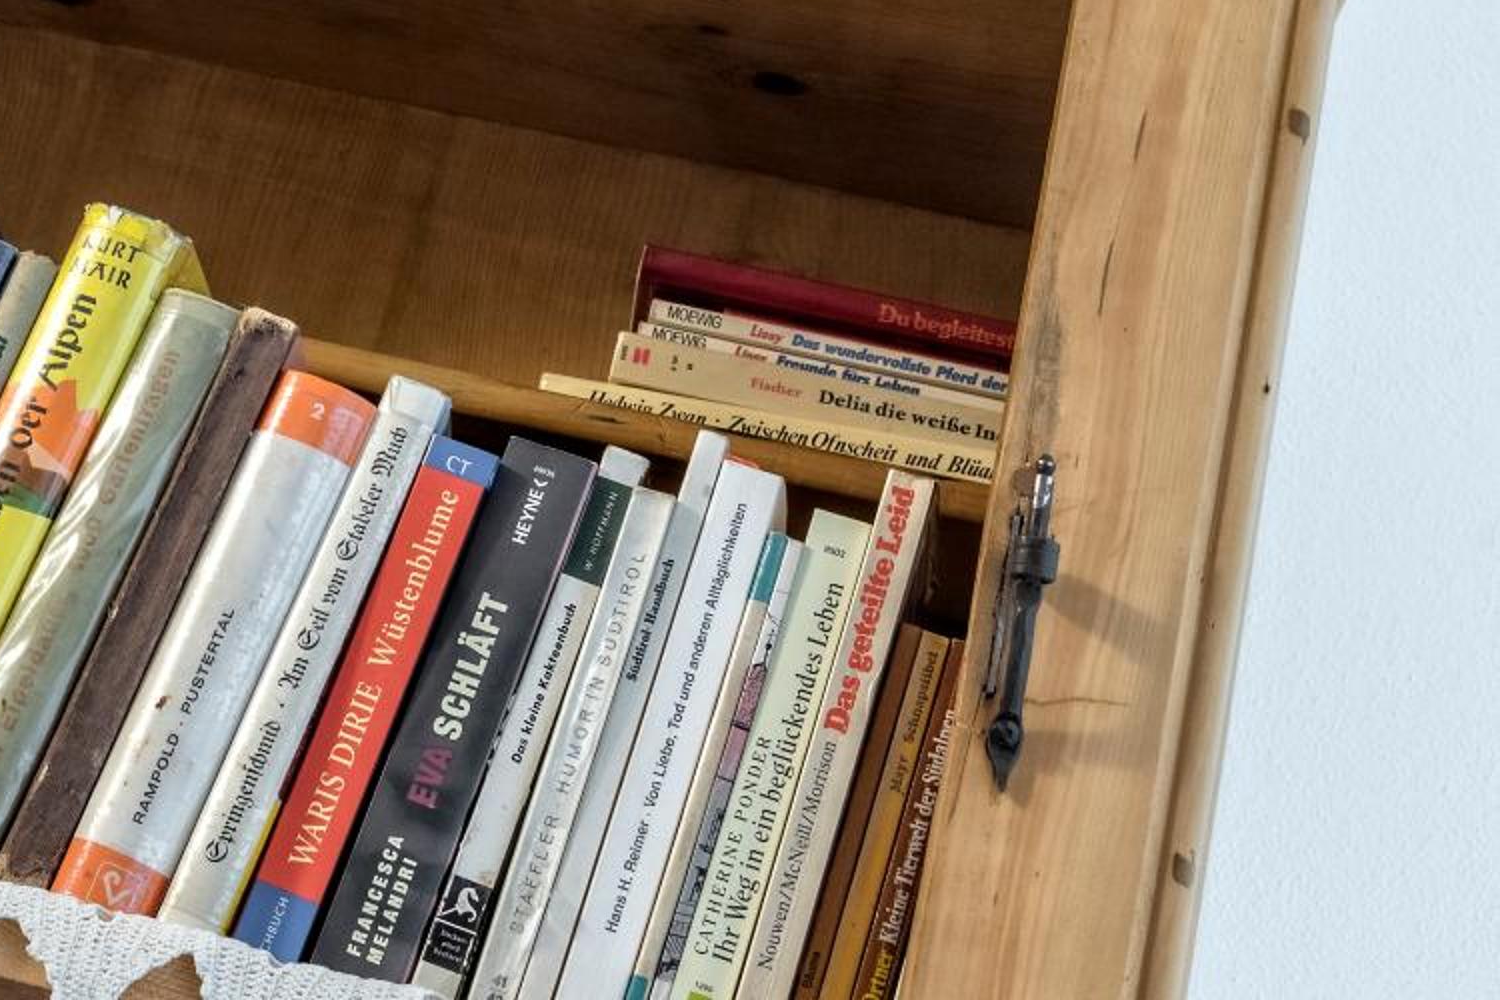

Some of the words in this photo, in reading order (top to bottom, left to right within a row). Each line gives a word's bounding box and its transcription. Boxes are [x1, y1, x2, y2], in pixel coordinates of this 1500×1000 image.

[32, 286, 102, 393] Alpen
[667, 305, 723, 328] MOEWIG
[877, 303, 909, 326] Du
[776, 355, 837, 378] Freunde
[841, 366, 871, 386] fürs
[875, 375, 921, 396] Leben
[792, 334, 820, 351] Das
[825, 344, 932, 375] wundervollste
[935, 365, 978, 386] Pferd
[982, 374, 1008, 393] der
[819, 389, 871, 414] Delia
[875, 402, 908, 422] die
[911, 411, 972, 436] weiße
[726, 413, 809, 448] Zwischen
[904, 451, 943, 472] und
[511, 485, 544, 546] HEYNE
[703, 501, 749, 612] Alltäglichkeiten
[623, 628, 652, 684] Südtirol
[642, 555, 676, 627] Handbuch
[806, 580, 844, 650] Leben
[821, 673, 861, 737] Das
[841, 552, 897, 677] geteilte
[873, 482, 916, 558] Leid
[428, 588, 511, 744] SCHLÄFT
[536, 601, 577, 690] Kakteenbuch
[685, 611, 715, 671] anderen
[286, 766, 347, 873] WARIS
[326, 676, 385, 771] DIRIE
[367, 486, 461, 673] Wüstenblume
[676, 671, 696, 702] und
[129, 730, 182, 826] RAMPOLD
[177, 605, 237, 716] PUSTERTAL
[518, 691, 545, 736] kleine
[553, 707, 595, 796] HUMOR
[584, 675, 605, 702] IN
[666, 701, 686, 731] Tod
[757, 648, 827, 806] beglückendes
[405, 737, 454, 811] EVA
[509, 736, 528, 765] Das
[642, 778, 662, 810] Von
[622, 819, 650, 873] Reimer
[693, 829, 744, 957] CATHERINE
[732, 734, 773, 825] PONDER
[747, 804, 777, 845] ein
[616, 874, 633, 892] H.
[738, 844, 764, 874] in
[878, 885, 910, 947] Kleine
[894, 816, 926, 889] Tierwelt
[915, 784, 936, 818] der
[344, 831, 405, 959] FRANCESCA
[364, 855, 418, 966] MELANDRI
[604, 893, 627, 935] Hans
[723, 874, 760, 926] Weg
[710, 924, 741, 966] Ihr
